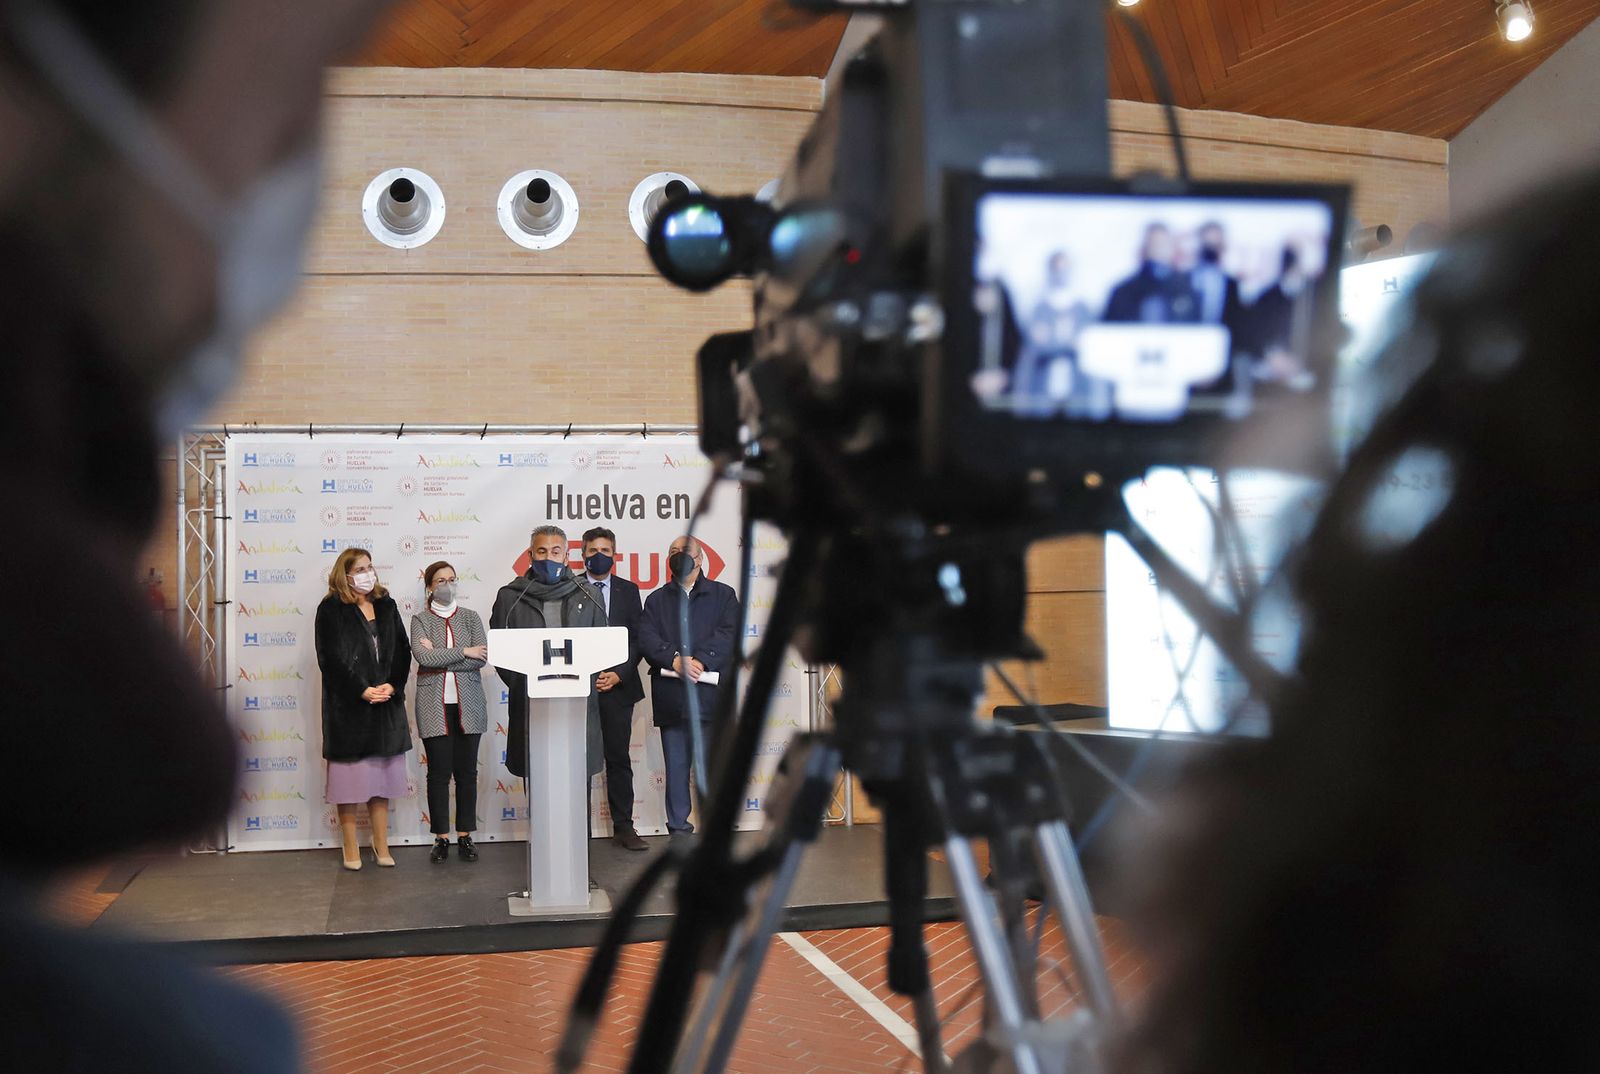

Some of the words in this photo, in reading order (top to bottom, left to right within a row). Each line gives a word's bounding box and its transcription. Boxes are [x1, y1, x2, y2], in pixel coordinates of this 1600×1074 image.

[244, 453, 257, 463] H
[500, 454, 512, 463] H
[323, 480, 336, 489] H
[546, 484, 645, 520] Huelva
[656, 493, 690, 520] en
[245, 509, 257, 519] H
[323, 539, 336, 550] H
[245, 570, 257, 580] H
[245, 633, 257, 643] H
[542, 639, 573, 665] H
[246, 697, 258, 707] H
[247, 758, 259, 768] H
[747, 799, 759, 809] H
[503, 808, 514, 818] H
[247, 817, 259, 827] H
